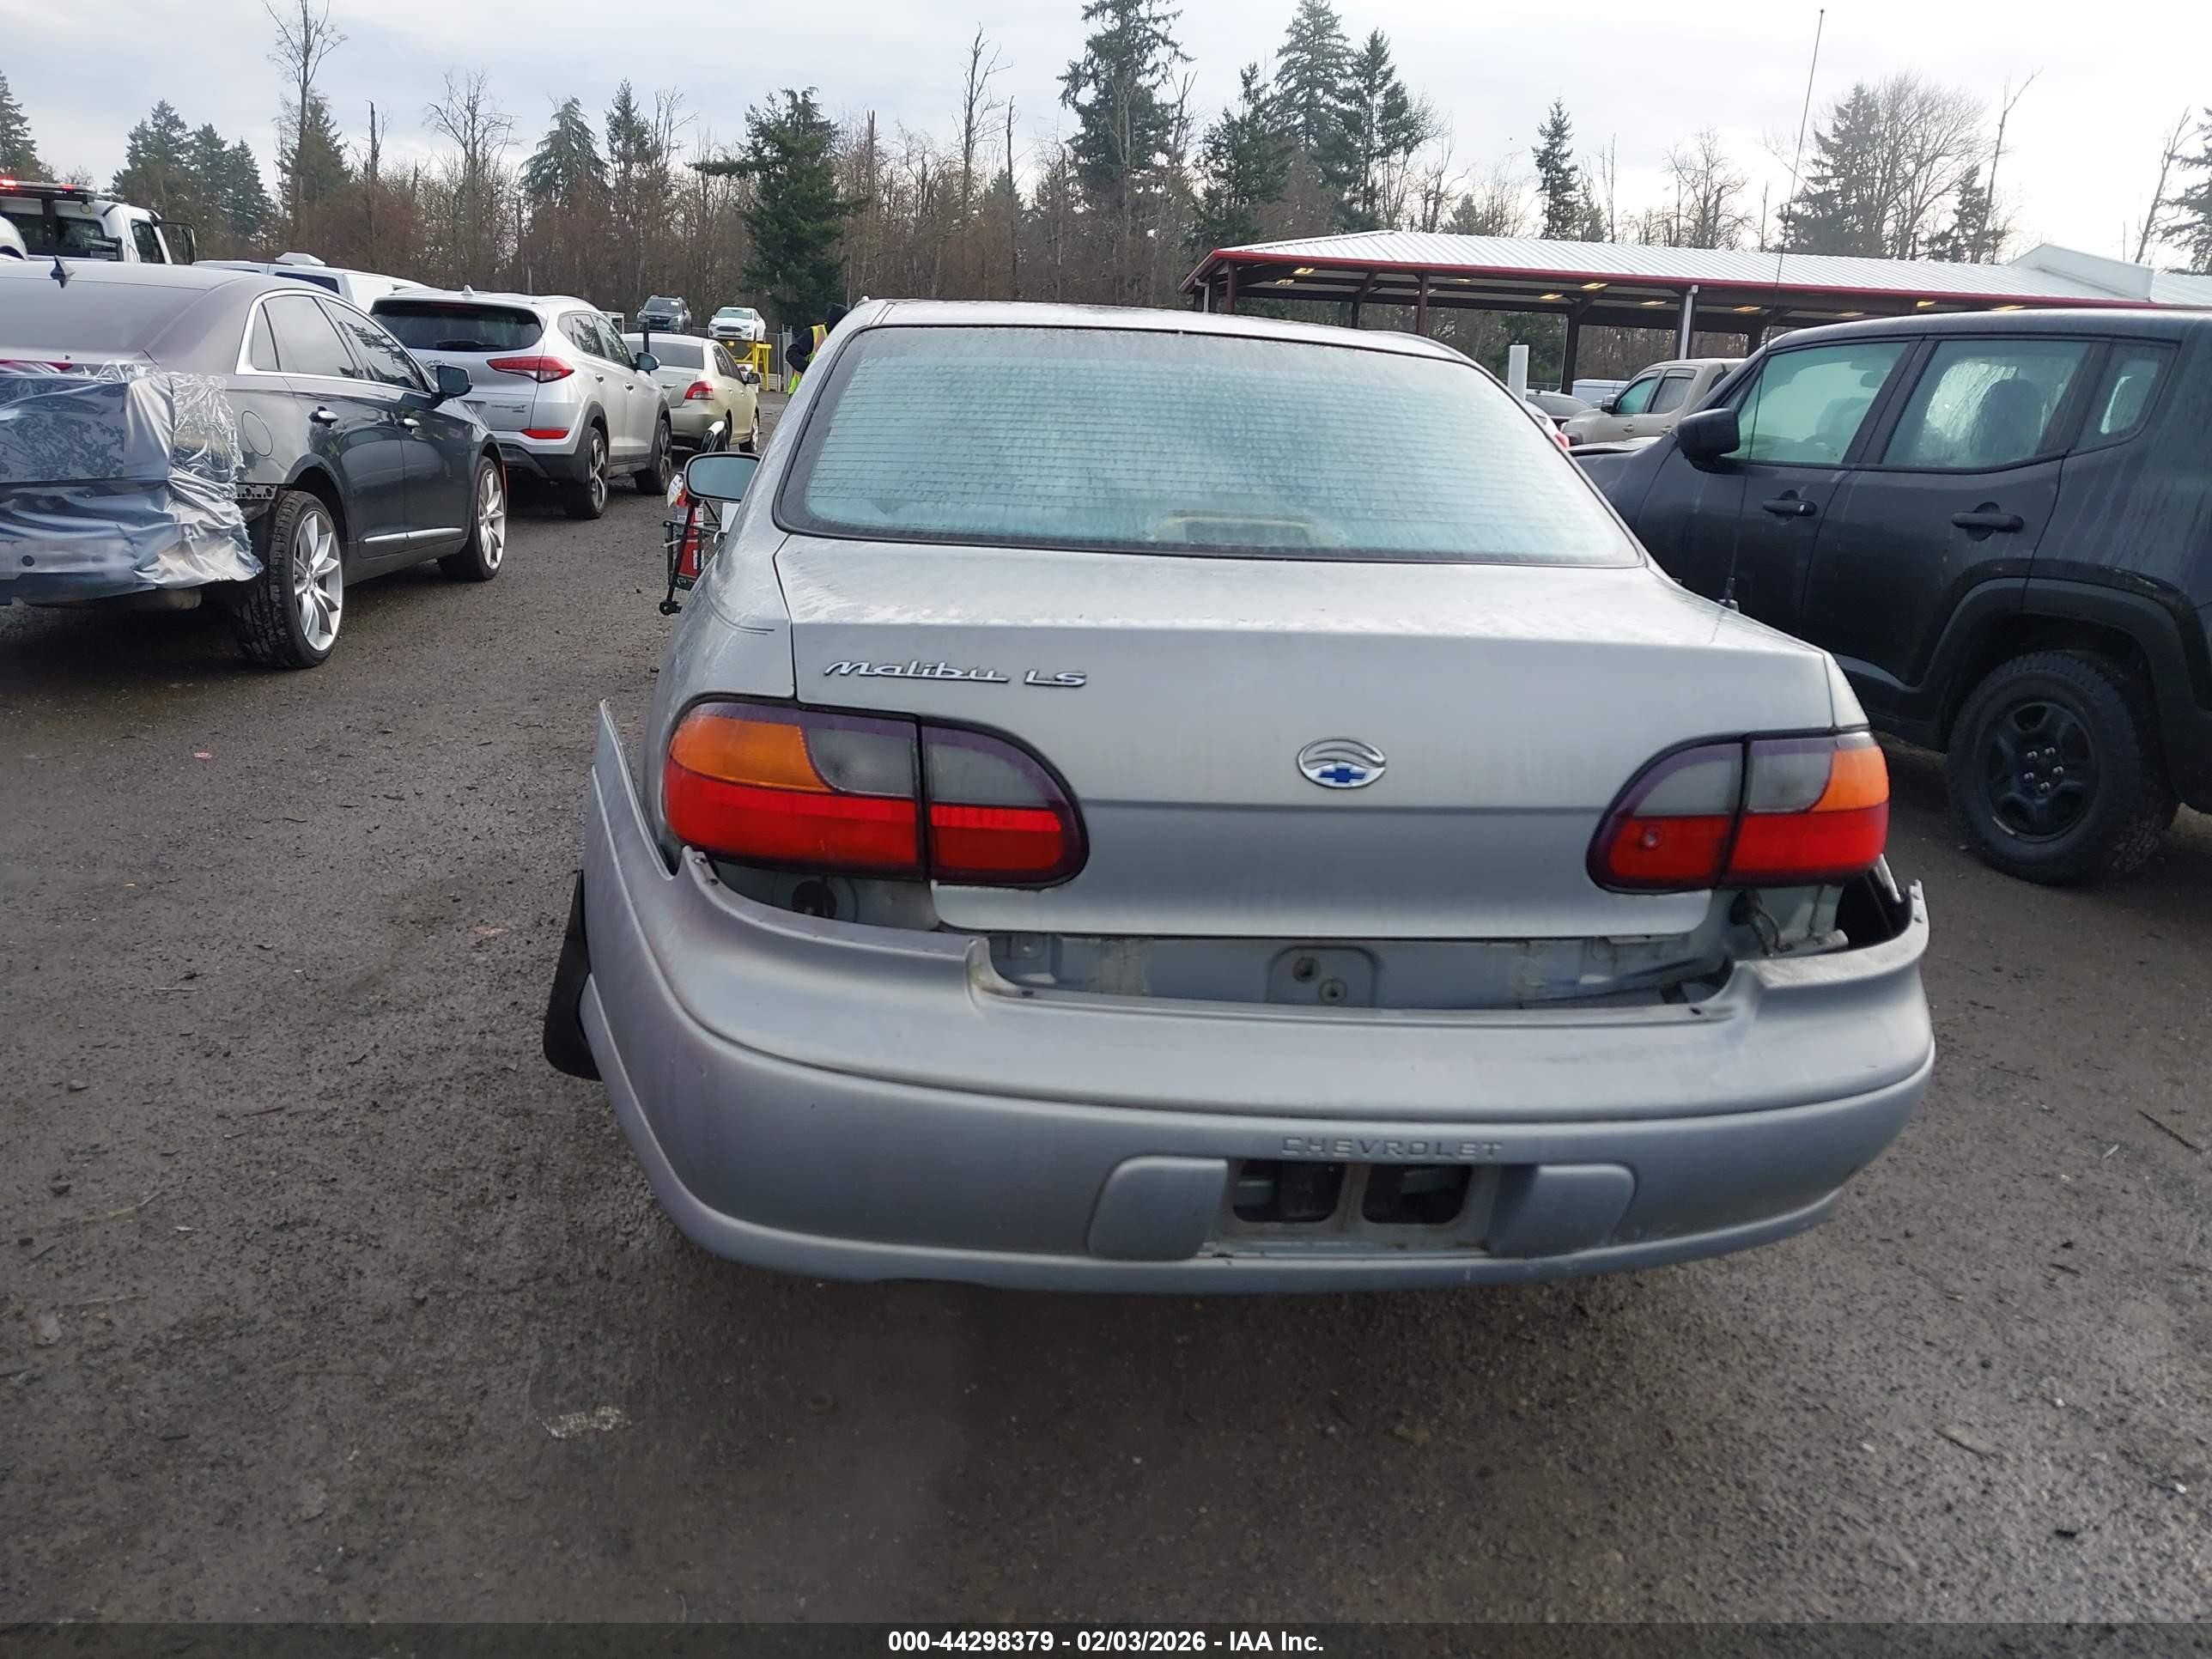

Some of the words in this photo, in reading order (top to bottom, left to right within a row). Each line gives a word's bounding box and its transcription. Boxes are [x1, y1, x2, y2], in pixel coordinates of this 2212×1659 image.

[824, 660, 1009, 683] Malibu
[1024, 671, 1085, 686] LS
[1282, 1138, 1503, 1158] CHEVROLET
